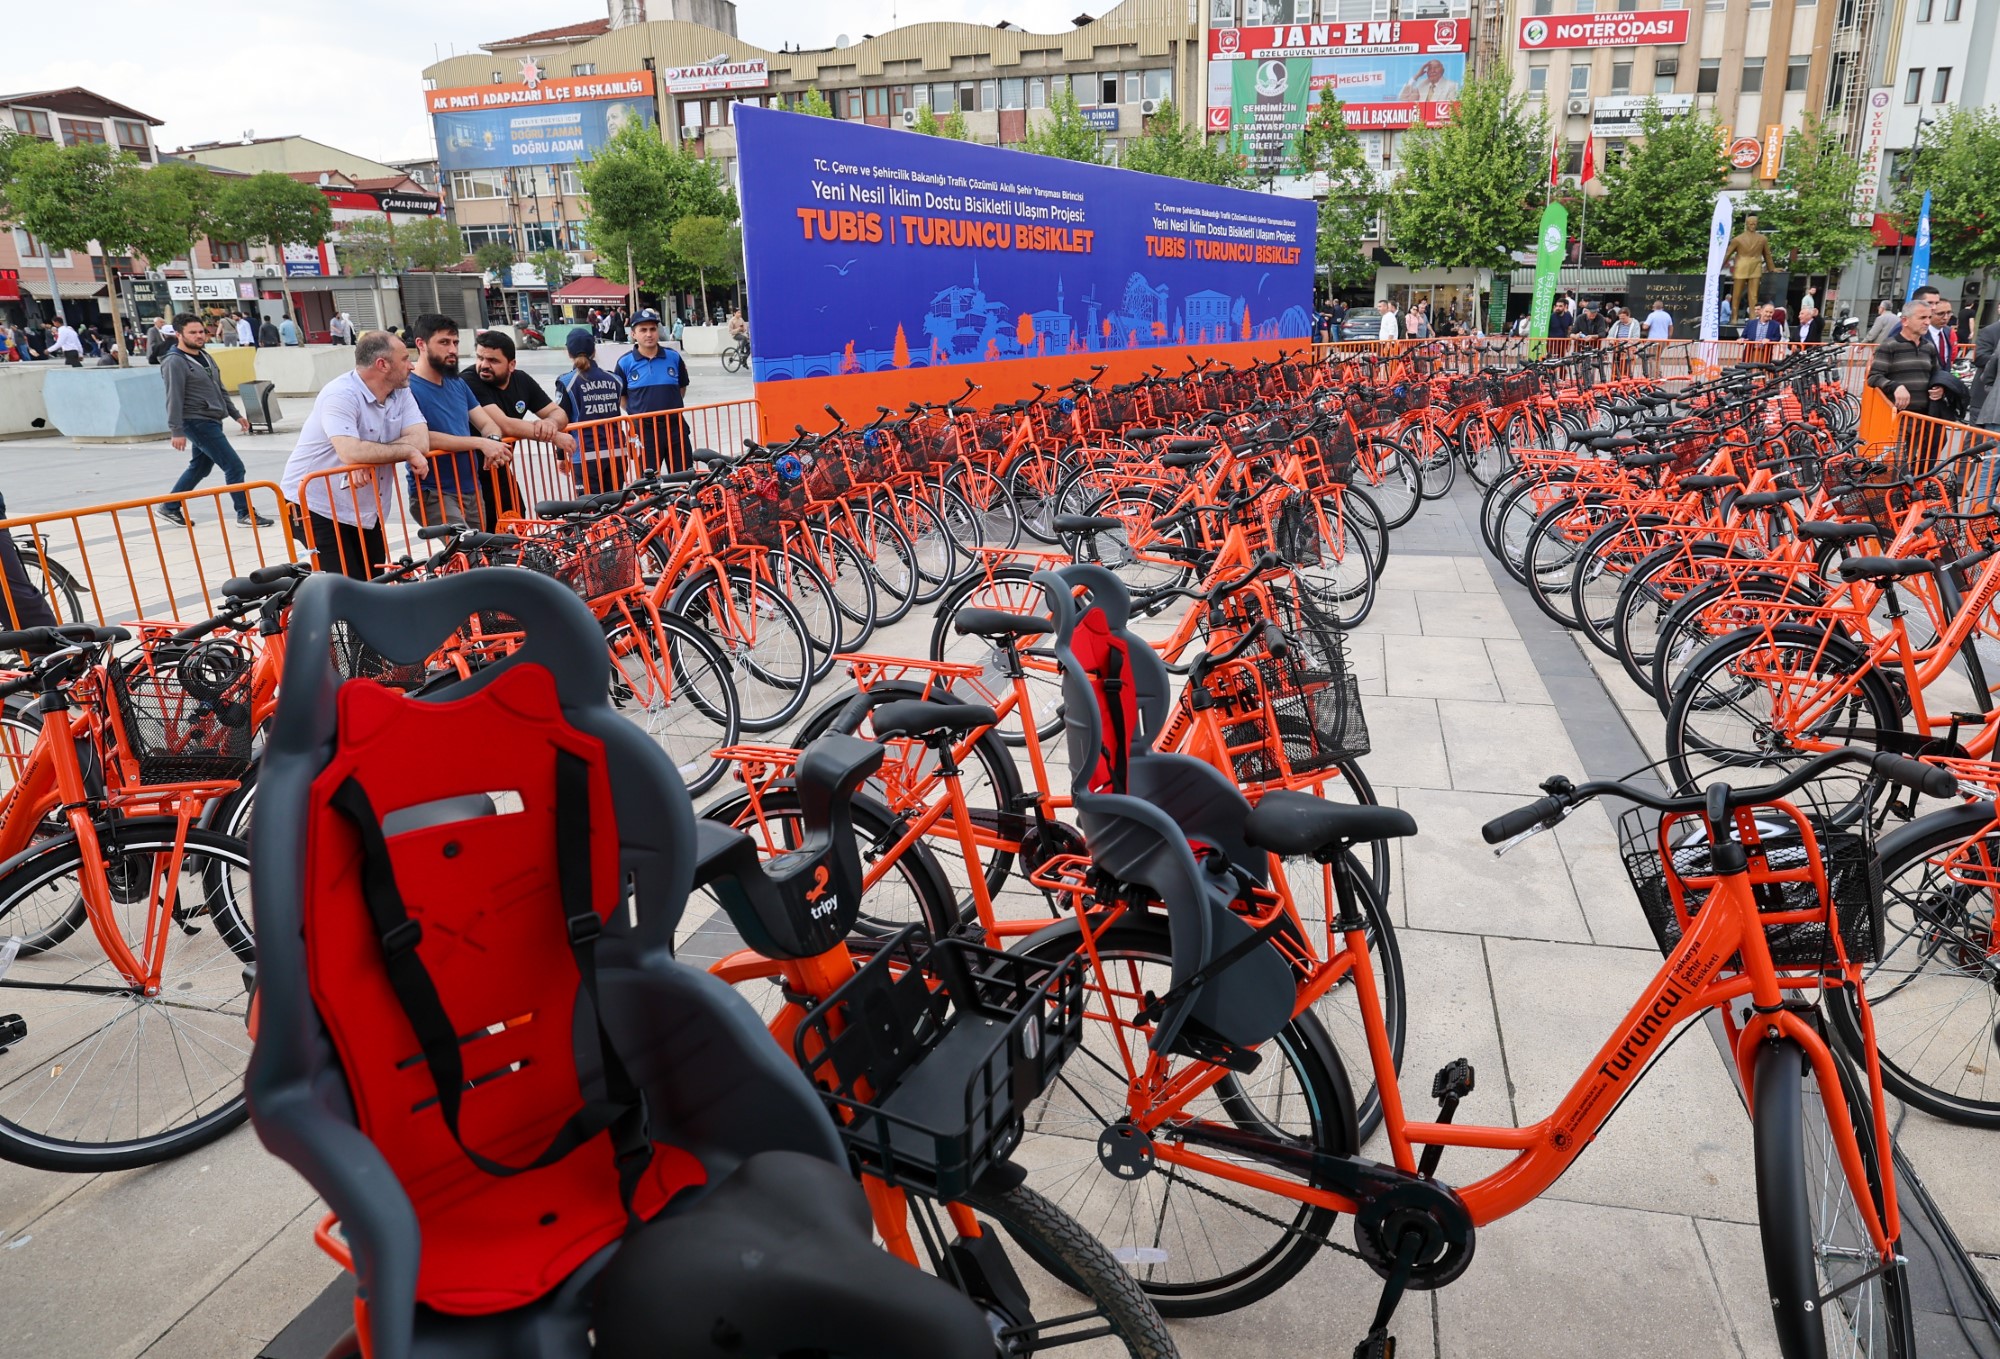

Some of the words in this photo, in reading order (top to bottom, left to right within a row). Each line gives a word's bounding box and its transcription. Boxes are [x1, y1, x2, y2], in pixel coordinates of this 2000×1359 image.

[1594, 14, 1635, 22] SAKARYA
[1556, 23, 1616, 38] NOTER
[1618, 20, 1674, 36] ODASI
[1587, 36, 1638, 46] BAŞKANLIĞI
[681, 63, 765, 79] KARAKADILAR
[433, 96, 448, 109] AK
[451, 92, 480, 107] PARTİ
[483, 89, 542, 105] ADAPAZARI
[545, 86, 571, 101] İLÇE
[574, 78, 643, 98] BAŞKANLIĞI
[1243, 103, 1297, 114] ŞEHRİMİZİN
[1362, 107, 1370, 124] İL
[1595, 110, 1620, 118] HUKUK
[1621, 109, 1631, 117] VE
[546, 126, 582, 138] ZAMAN
[512, 140, 549, 155] DOĞRU
[551, 139, 584, 153] ADAM
[1766, 127, 1779, 177] TRAVEL
[832, 161, 858, 174] Çevre
[860, 166, 870, 176] ve
[873, 166, 910, 180] Şehircilik
[911, 171, 946, 186] Bakanlığı
[947, 175, 967, 188] Trafik
[968, 178, 998, 191] Çözümlü
[999, 182, 1015, 194] Akıllı
[1017, 184, 1033, 195] Şehir
[1034, 186, 1061, 199] Yarışması
[1062, 190, 1084, 202] Birincisi
[811, 180, 845, 201] Yeni
[850, 184, 885, 204] Nesil
[889, 184, 921, 207] İklim
[925, 192, 961, 211] Dostu
[965, 196, 1012, 216] Bisikletli
[1014, 201, 1049, 220] Ulaşım
[1051, 205, 1085, 223] Projesi:
[901, 215, 1011, 248] TURUNCU
[1152, 217, 1169, 230] Yeni
[1170, 219, 1188, 233] Nesil
[1189, 219, 1207, 234] İklim
[1208, 223, 1227, 236] Dostu
[1228, 227, 1255, 239] Bisikletli
[1255, 229, 1275, 242] Ulaşım
[1195, 240, 1253, 263] TURUNCU
[580, 380, 616, 393] SAKARYA
[582, 392, 618, 402] BÜYÜKŞEHİR
[585, 402, 618, 415] ZABITA
[811, 894, 838, 920] tripy
[1672, 941, 1702, 974] Sakarya
[1681, 959, 1702, 983] Şehir
[1690, 953, 1720, 988] Bisikleti
[1598, 988, 1683, 1081] Turuncu
